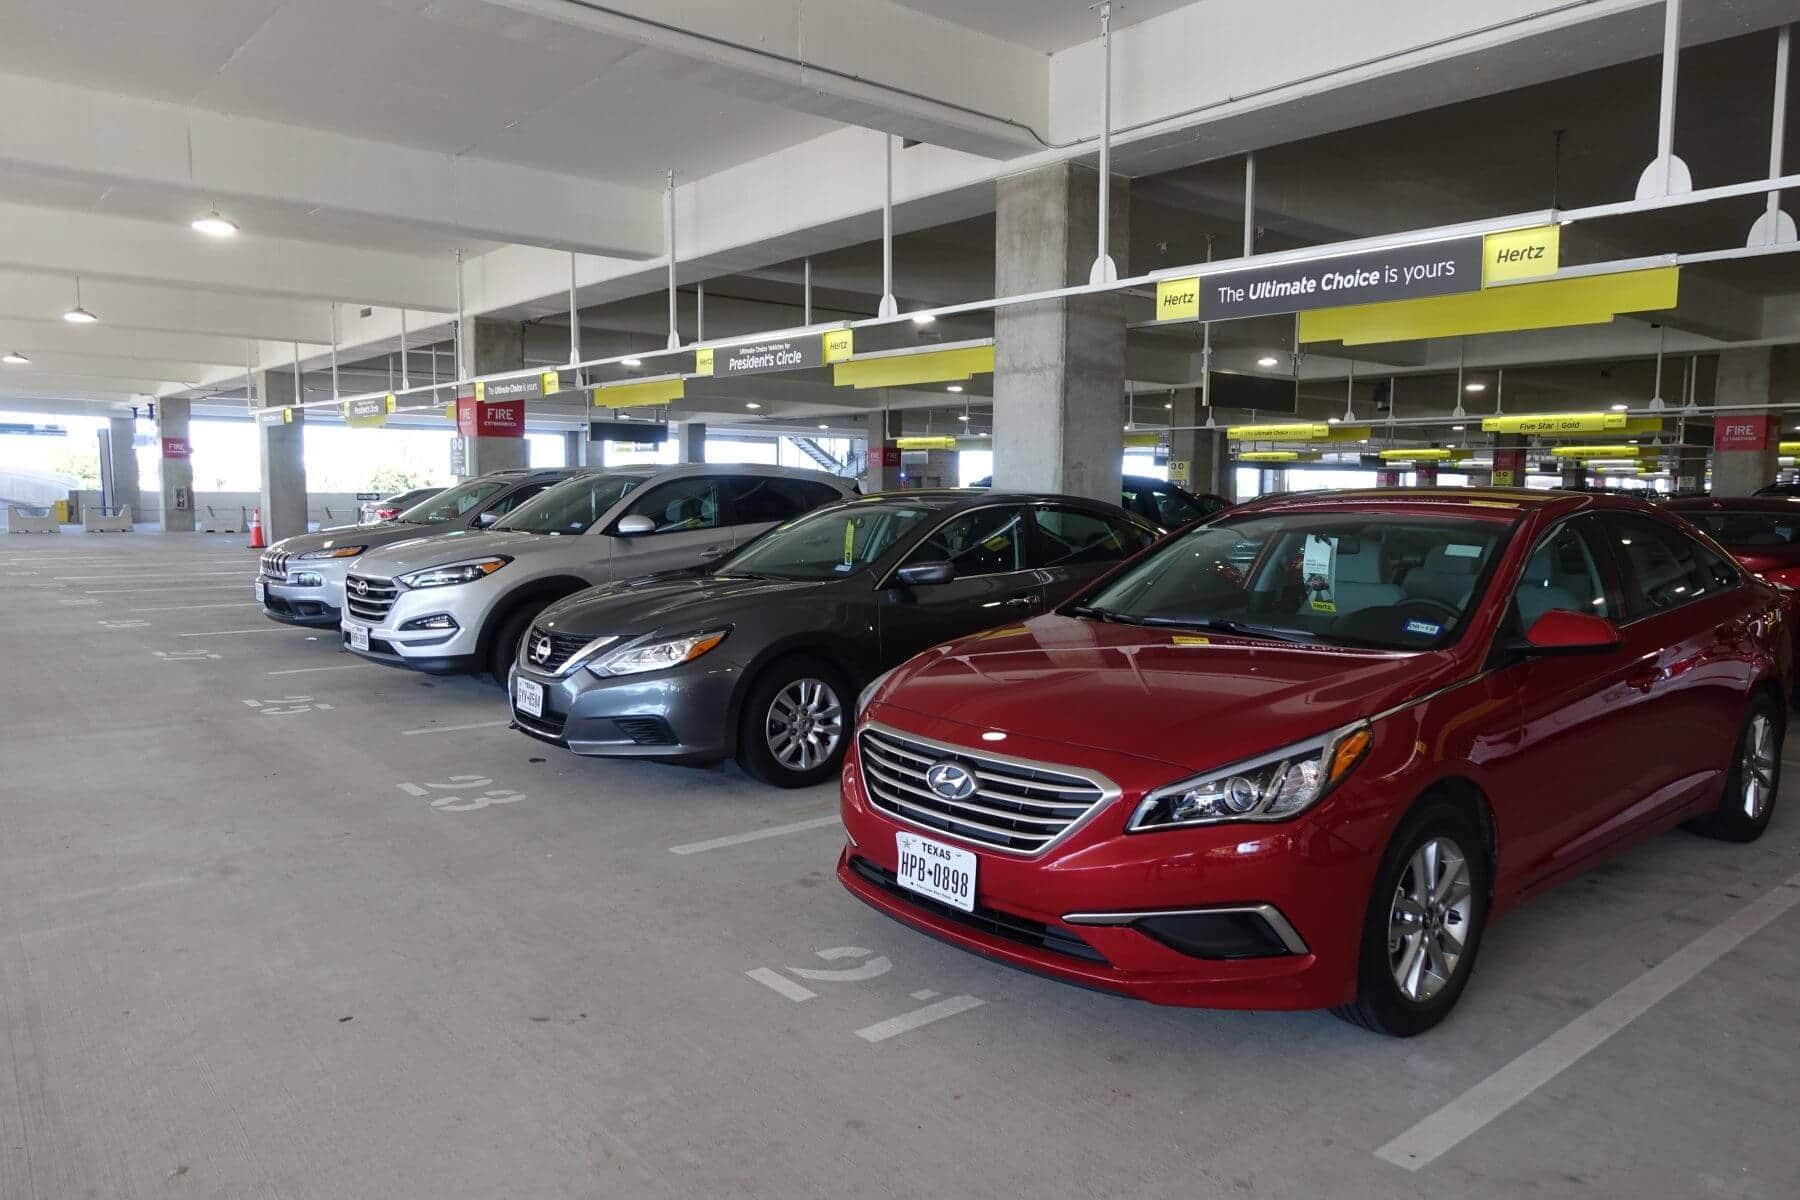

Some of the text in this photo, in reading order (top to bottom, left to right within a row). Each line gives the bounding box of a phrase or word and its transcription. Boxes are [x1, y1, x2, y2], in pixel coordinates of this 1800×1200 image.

[1497, 245, 1545, 264] Hertz
[1218, 260, 1456, 303] The Ultimate Choice is yours
[1163, 291, 1194, 307] Hertz
[829, 341, 848, 350] Hertz
[729, 350, 802, 371] President's Circle
[487, 408, 514, 420] FIRE
[1519, 421, 1580, 431] Five Star Gold
[1726, 425, 1753, 436] FIRE
[922, 842, 951, 860] TEXAS
